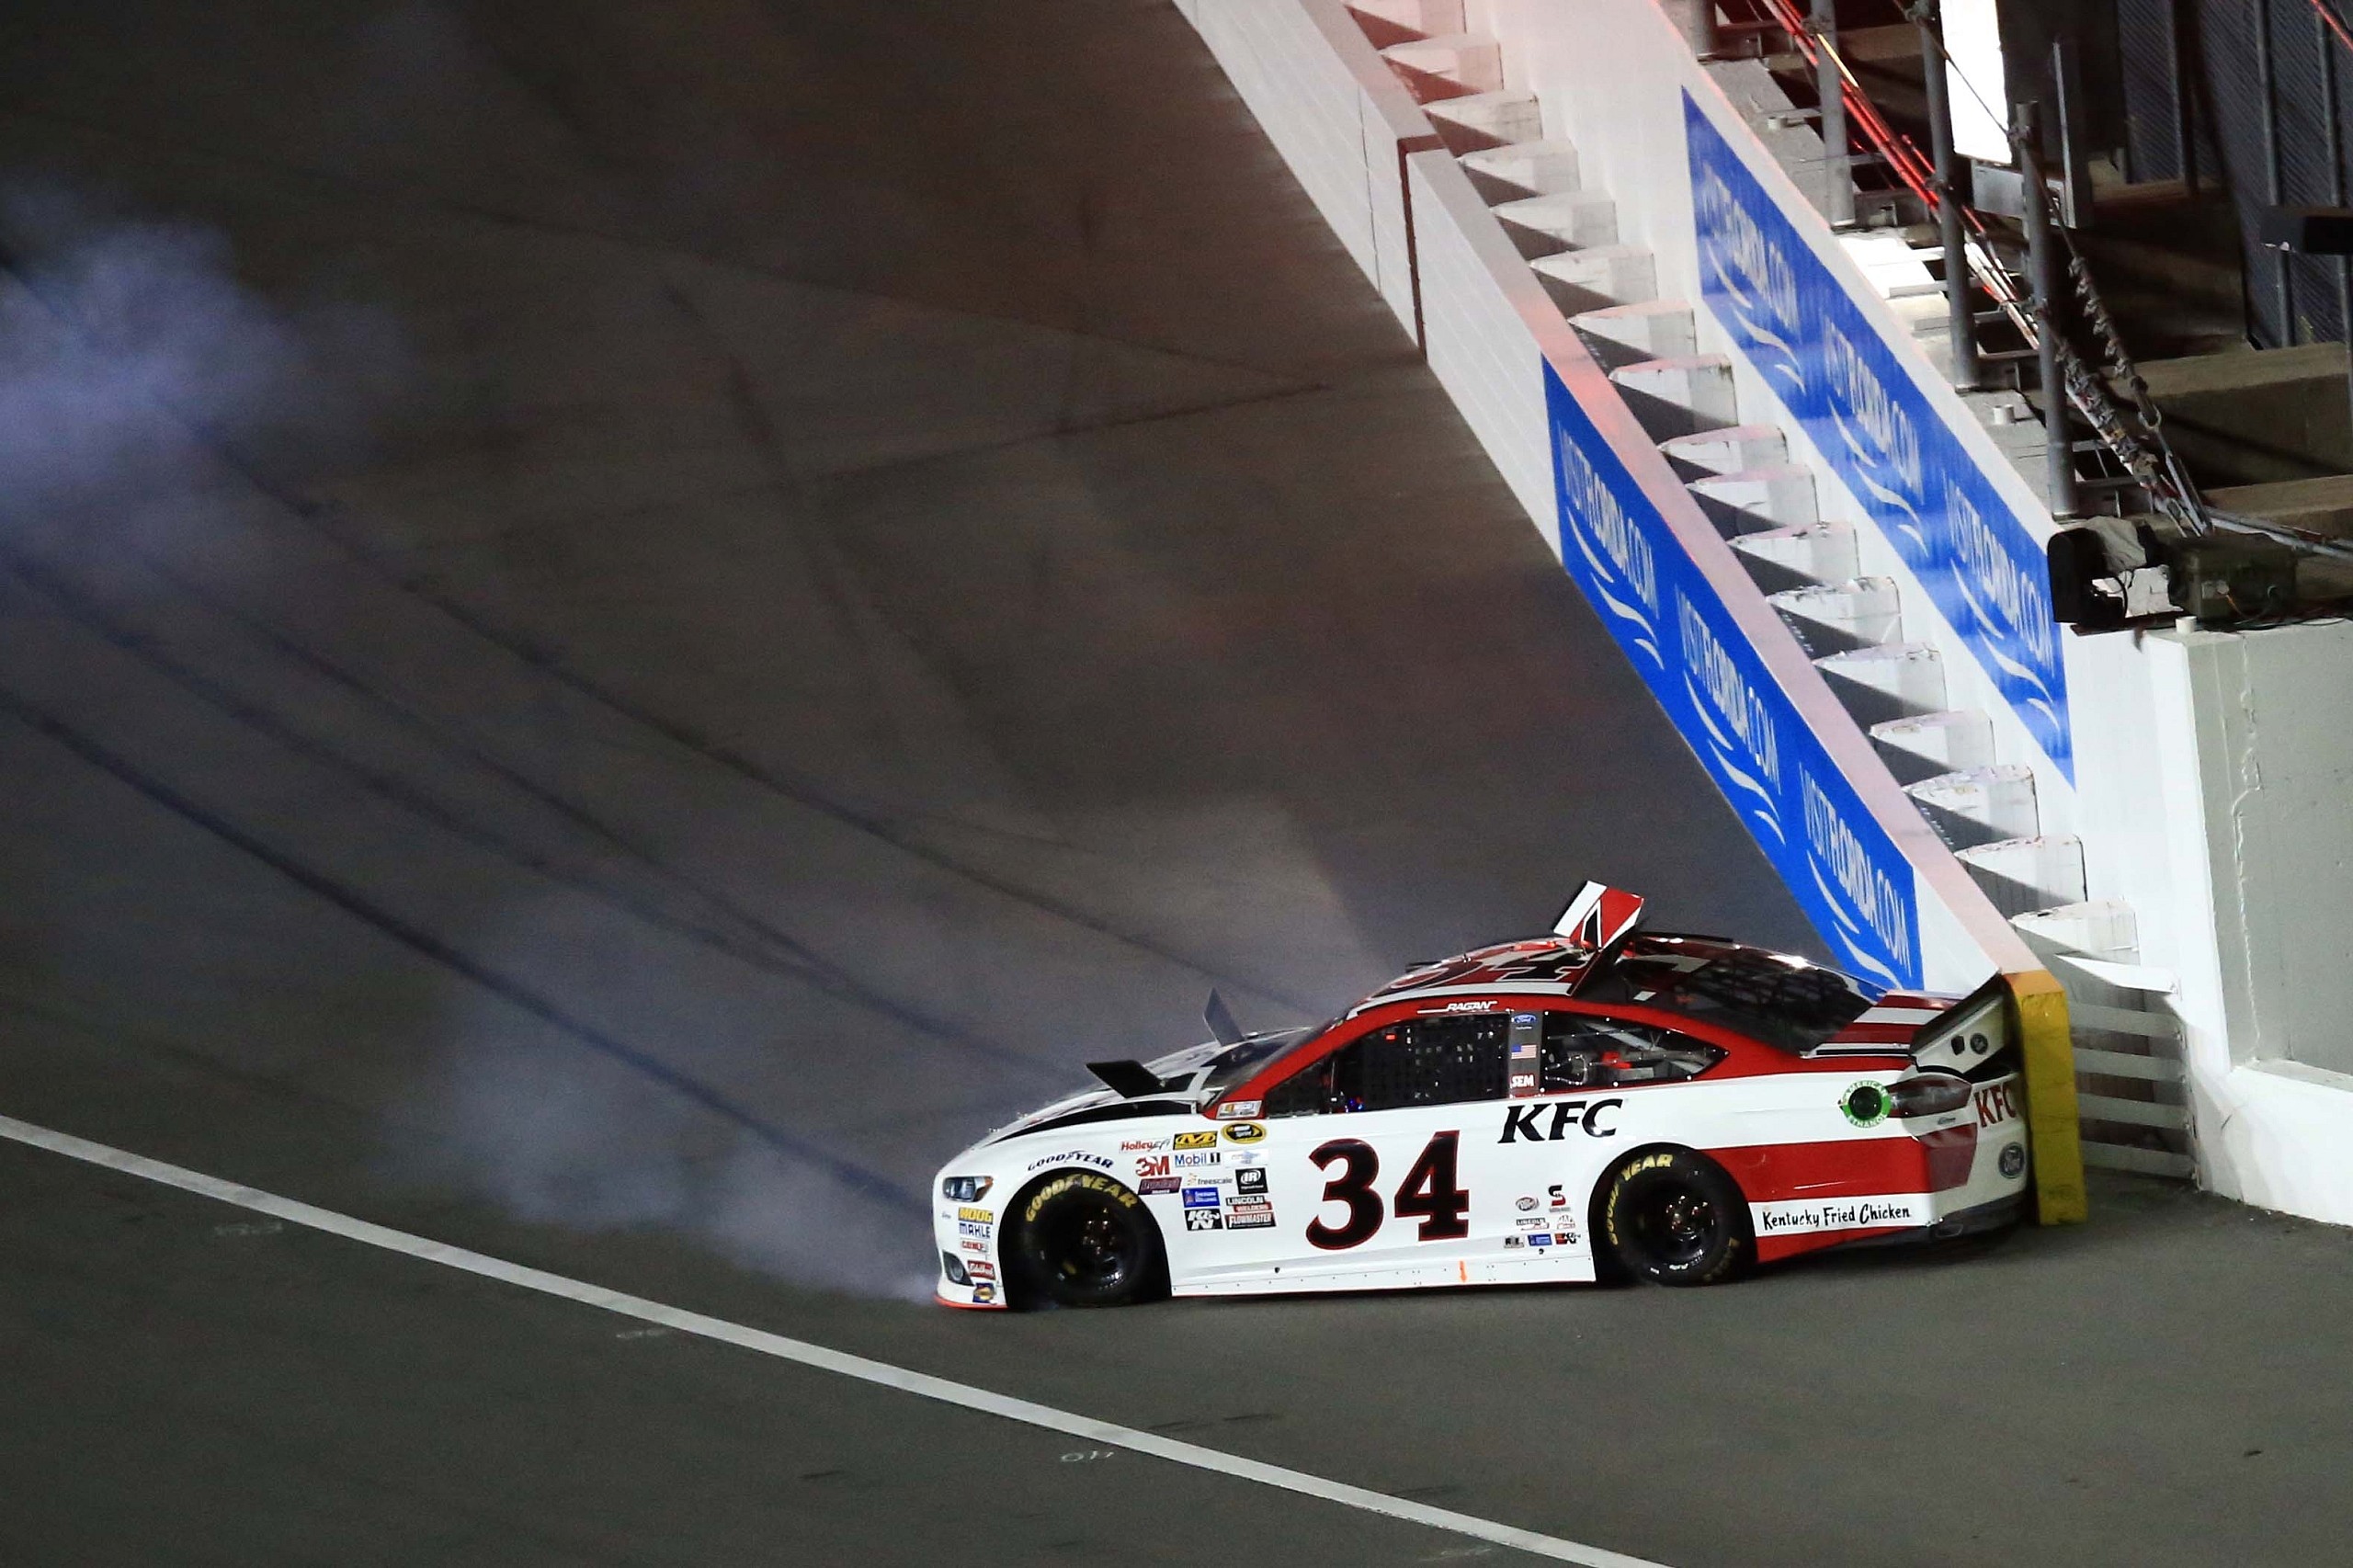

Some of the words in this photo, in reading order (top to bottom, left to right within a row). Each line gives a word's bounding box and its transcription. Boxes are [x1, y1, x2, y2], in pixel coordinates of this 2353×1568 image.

[1439, 1001, 1497, 1012] RAGAN
[1511, 1074, 1534, 1087] SEM
[1974, 1082, 2017, 1128] KFC
[1497, 1098, 1623, 1143] KFC
[1121, 1141, 1154, 1152] Holley
[1028, 1150, 1114, 1171] GOODYEAR
[1135, 1155, 1170, 1176] 3M
[1175, 1153, 1206, 1165] Mobil
[1198, 1176, 1233, 1185] freescale
[1026, 1174, 1137, 1221] GOODYEAR
[1305, 1130, 1469, 1250] 34
[1228, 1196, 1263, 1205] LINCOLN
[1229, 1213, 1271, 1228] FLOWMASTER
[1762, 1210, 1819, 1231] Kentucky
[1823, 1206, 1855, 1226] Fried
[1859, 1203, 1910, 1224] Chicken
[960, 1223, 991, 1238] MAHLE
